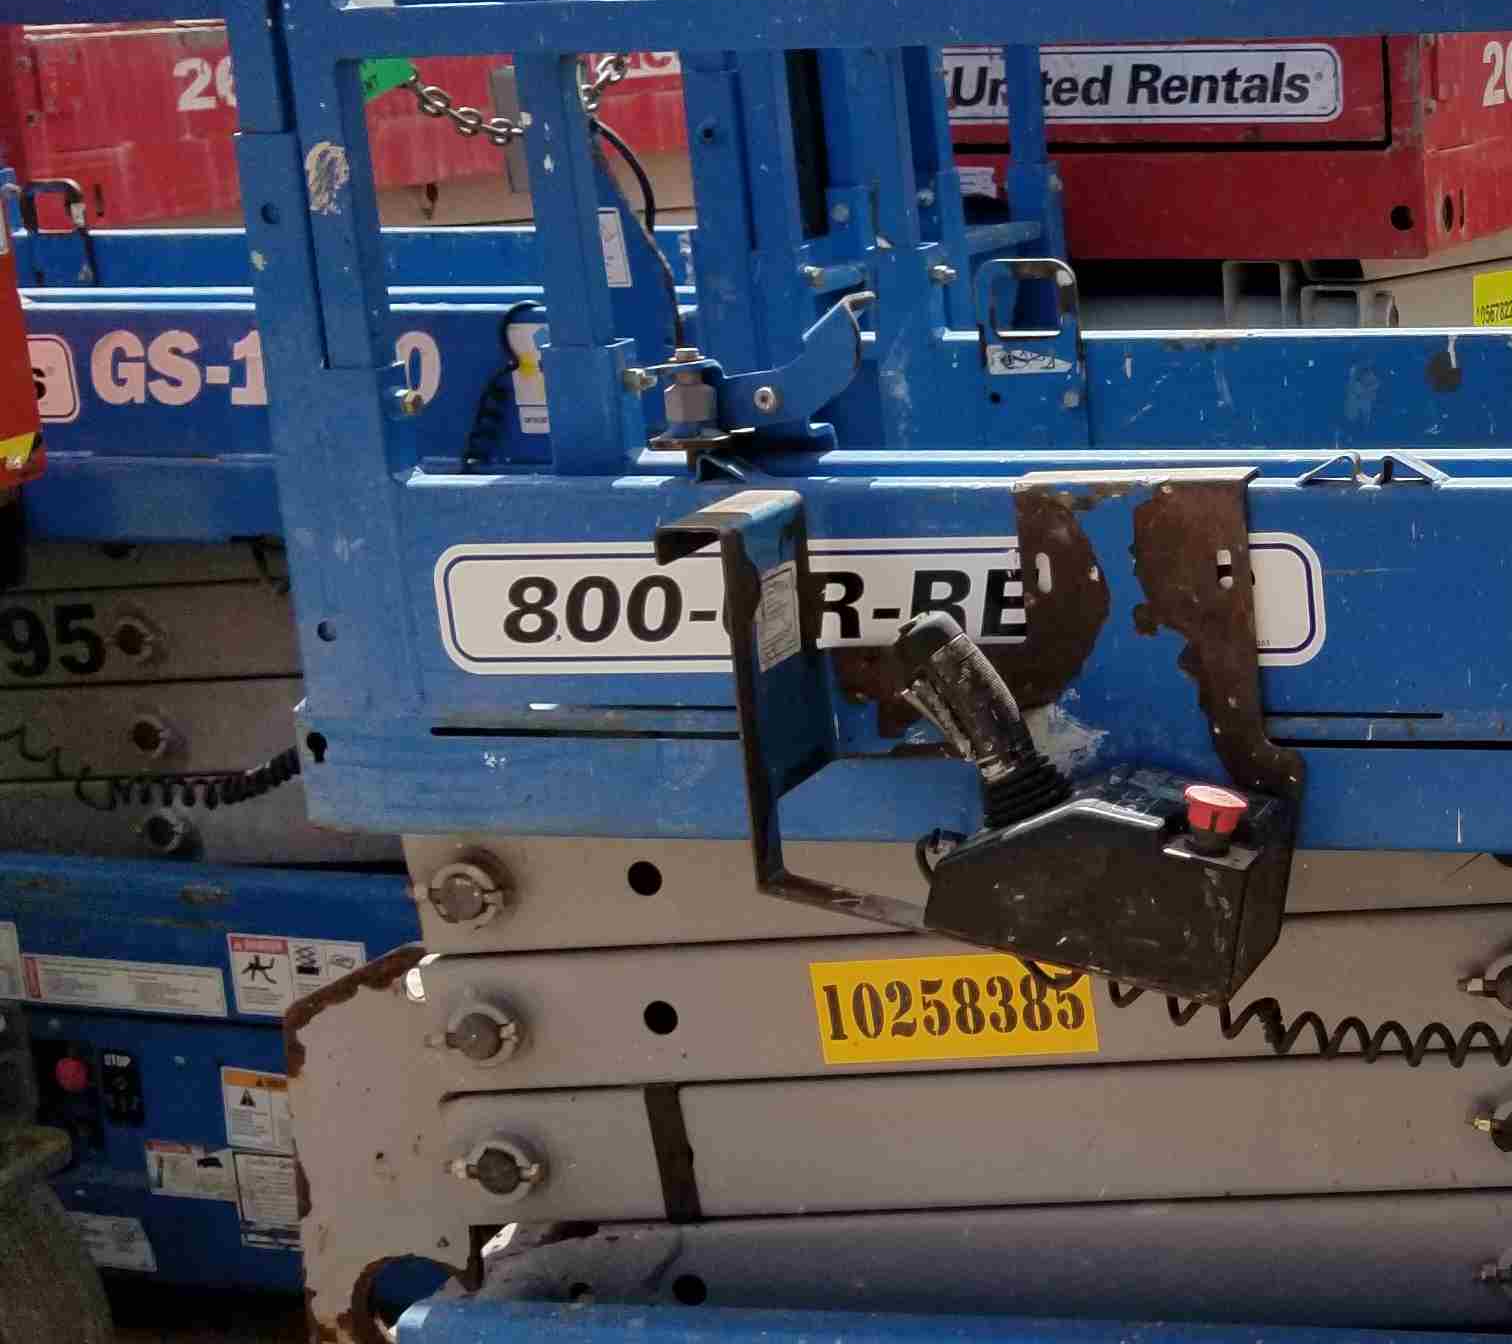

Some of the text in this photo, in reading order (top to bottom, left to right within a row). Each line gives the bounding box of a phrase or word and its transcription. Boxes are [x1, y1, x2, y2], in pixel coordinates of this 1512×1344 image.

[951, 62, 1311, 108] Unted Rentals
[822, 974, 1086, 1040] 10258385
